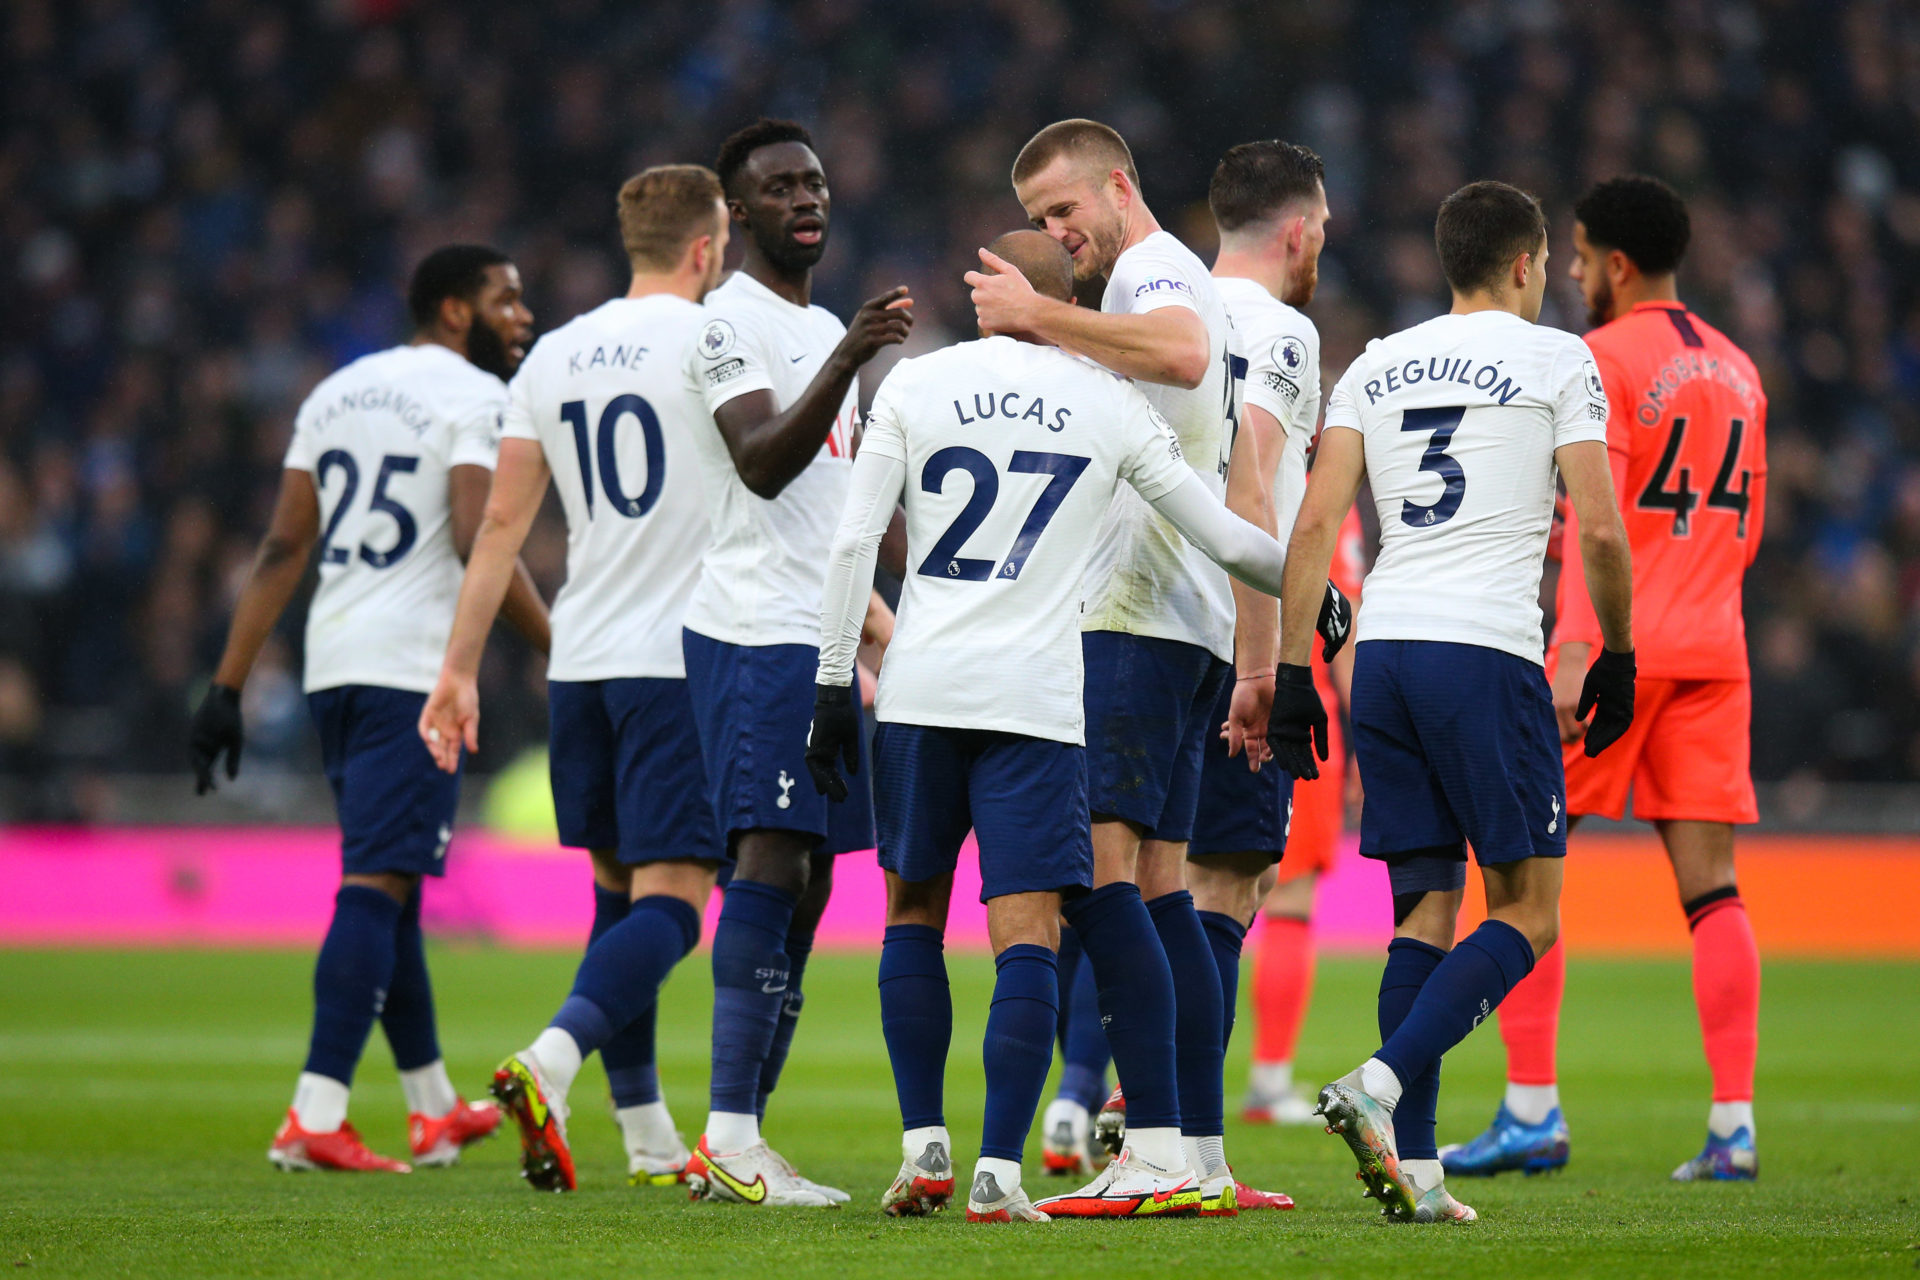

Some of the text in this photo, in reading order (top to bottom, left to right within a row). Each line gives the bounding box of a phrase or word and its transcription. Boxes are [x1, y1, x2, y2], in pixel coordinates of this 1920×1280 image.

[567, 344, 651, 376] KANE
[1364, 357, 1522, 406] REGUILÓN
[1637, 354, 1759, 426] OMOBAMID
[560, 393, 666, 522] 10
[953, 392, 1072, 433] LUCAS
[316, 448, 420, 569] 25
[916, 445, 1092, 582] 27
[1400, 405, 1467, 528] 3
[1636, 416, 1751, 539] 44
[755, 968, 790, 980] SPU
